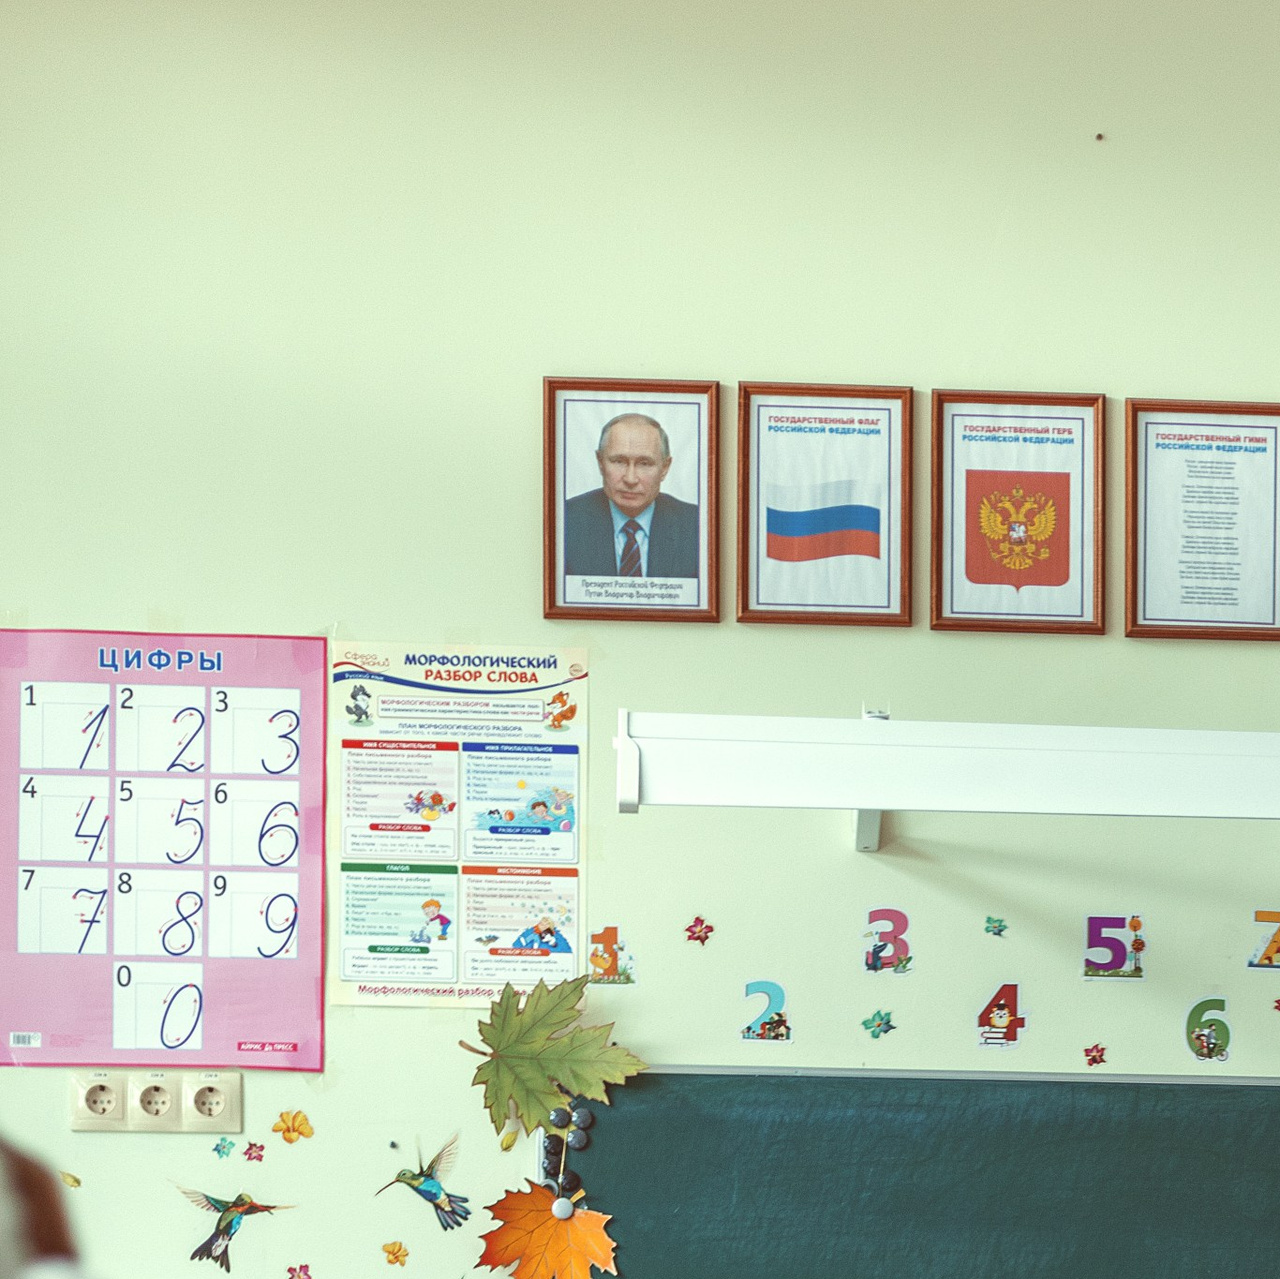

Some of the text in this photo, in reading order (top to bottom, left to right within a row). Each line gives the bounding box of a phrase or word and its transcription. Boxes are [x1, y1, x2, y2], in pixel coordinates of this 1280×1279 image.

[768, 416, 880, 427] ГОСУДАРСТВЕННЫЙ ФЛАГ
[768, 425, 881, 436] РОССИЙСКОЙ ФЕДЕРАЦИИ
[964, 425, 1073, 436] ГОСУДАРСТВЕННЫЙ ГЕРБ
[962, 434, 1075, 445] РОССИЙСКОЙ ФЕДЕРАЦИИ
[1155, 442, 1267, 454] РОССИЙСКОЙ ФЕДЕРАЦИИ
[1156, 433, 1267, 446] ГОСУДАРСТВЕННЫЙ ГИМН
[98, 647, 224, 673] ЦИФРЫ
[404, 653, 558, 670] МОРФОЛОГИЧЕСКИЙ
[424, 669, 539, 683] РАЗБОР СЛОВА
[24, 685, 37, 706] 1
[120, 688, 134, 710] 2
[215, 690, 229, 713] 3
[80, 704, 110, 769] 1
[166, 707, 205, 772] 2
[261, 709, 300, 774] 3
[22, 776, 38, 798] 4
[120, 780, 133, 802] 5
[214, 782, 228, 804] 6
[75, 796, 110, 862] 4
[166, 799, 204, 864] 5
[258, 801, 299, 867] 6
[22, 869, 35, 891] 7
[118, 872, 132, 894] 8
[214, 875, 228, 897] 9
[72, 888, 108, 954] 7
[162, 890, 203, 956] 8
[257, 893, 298, 958] 9
[868, 908, 911, 970] 3
[1084, 916, 1128, 974] 5
[590, 926, 620, 980] 1
[117, 965, 132, 987] 0
[160, 983, 203, 1050] 0
[741, 980, 791, 1040] 2
[977, 983, 1025, 1042] 4
[1185, 998, 1231, 1060] 6
